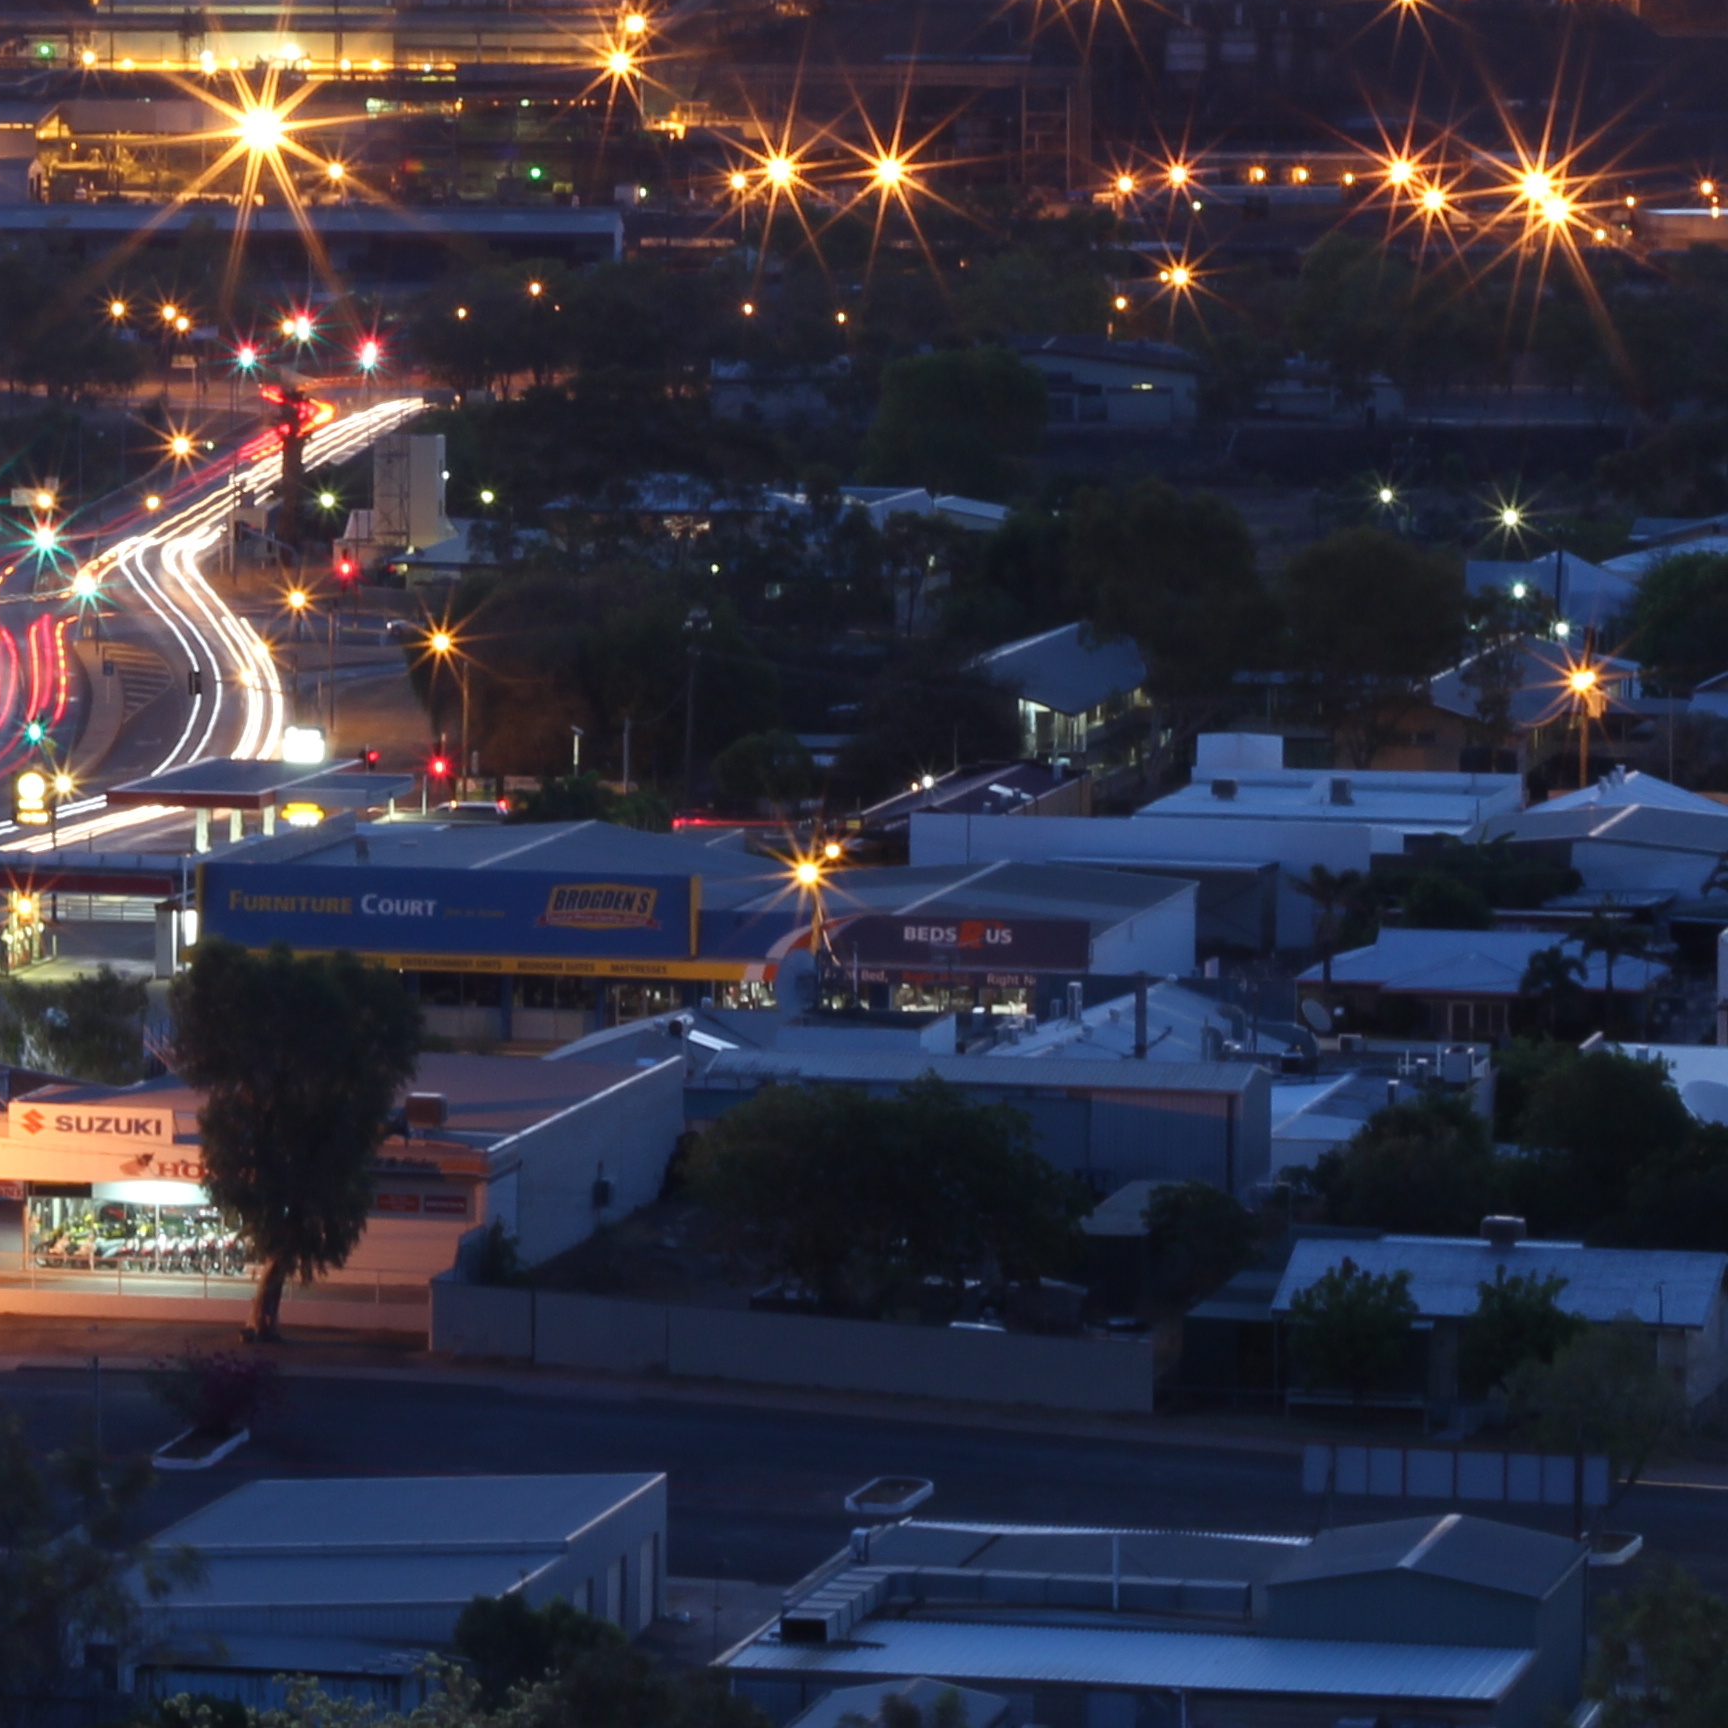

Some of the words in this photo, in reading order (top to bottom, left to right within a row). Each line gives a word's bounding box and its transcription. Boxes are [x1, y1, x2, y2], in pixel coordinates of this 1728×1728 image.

[904, 926, 957, 943] BEDS
[985, 928, 1013, 945] US
[55, 1115, 162, 1136] SUZUKI
